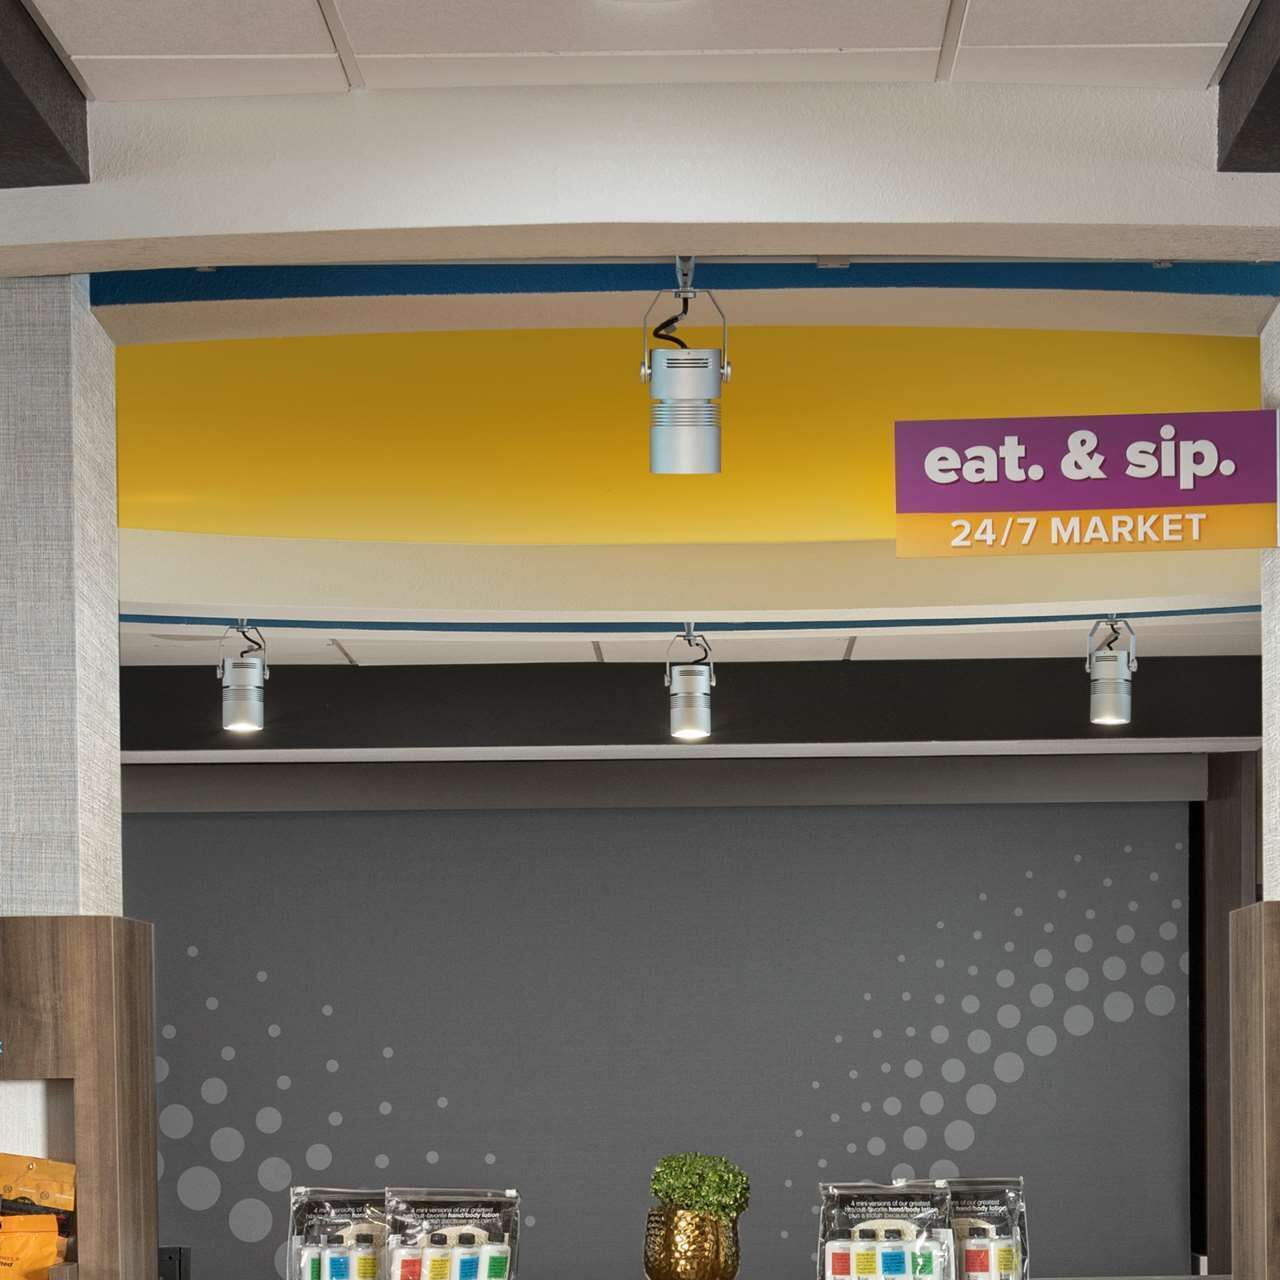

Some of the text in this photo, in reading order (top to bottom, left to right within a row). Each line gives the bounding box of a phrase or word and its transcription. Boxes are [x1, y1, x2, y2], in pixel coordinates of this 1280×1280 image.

[924, 424, 1237, 490] eat. & sip.
[950, 513, 1207, 548] 24/7 MARKET
